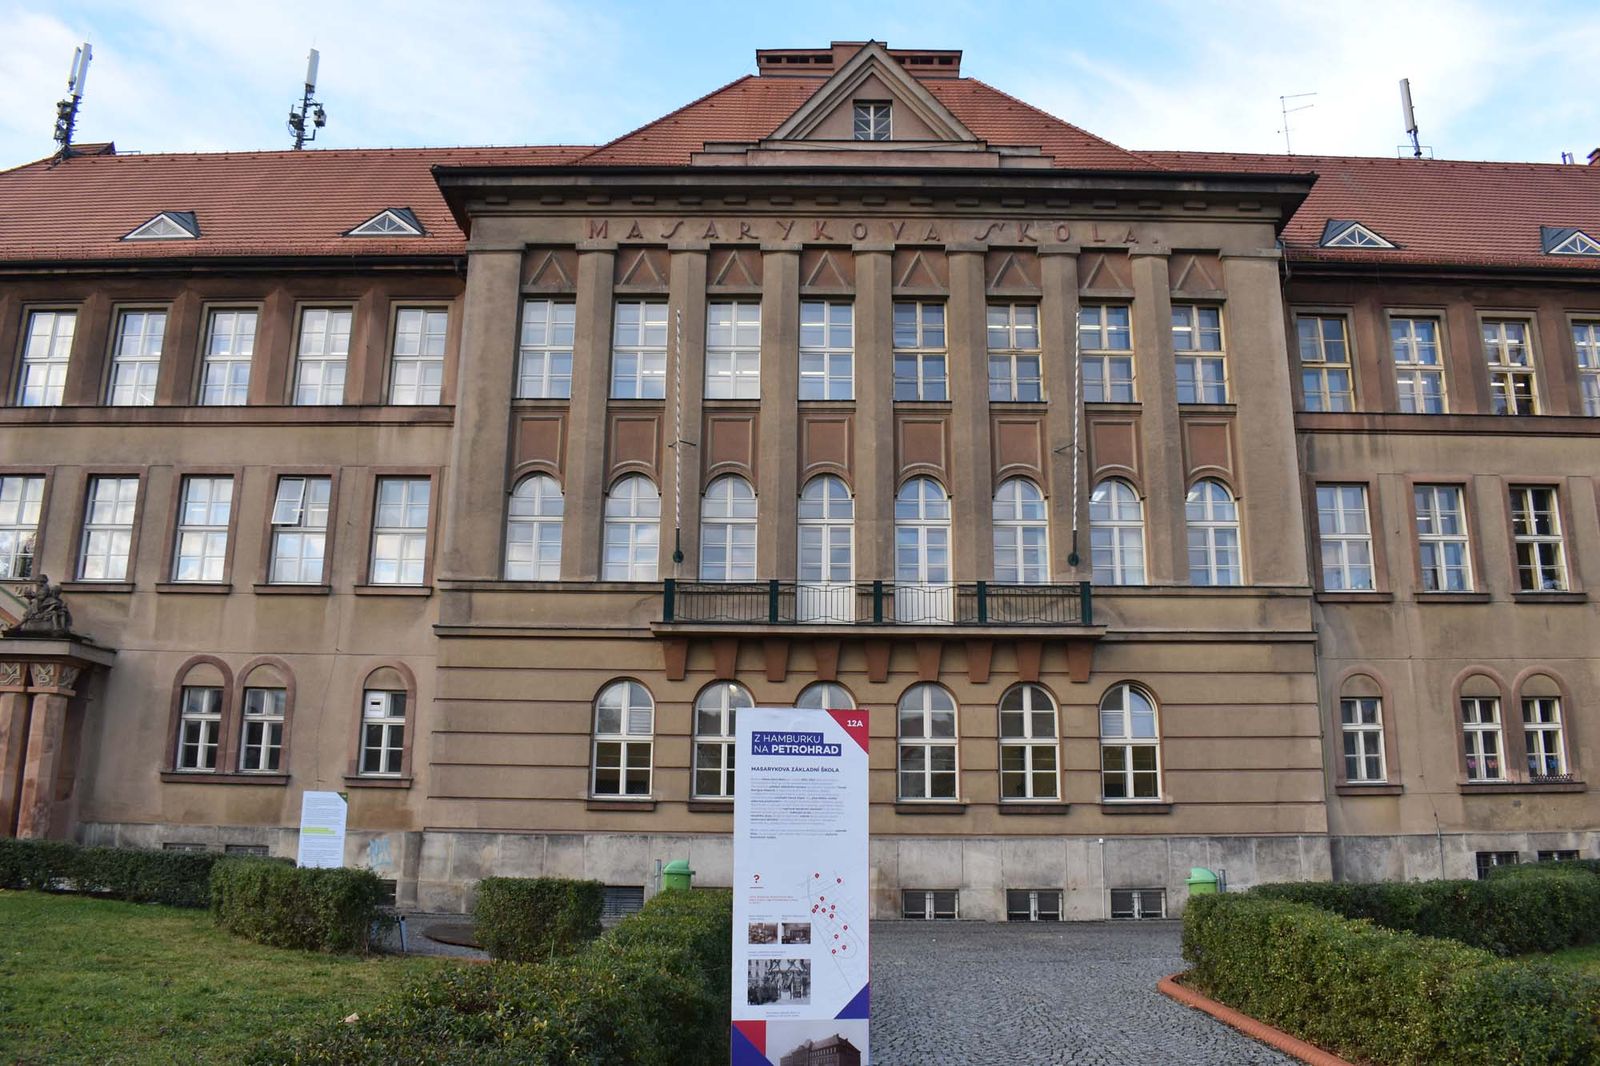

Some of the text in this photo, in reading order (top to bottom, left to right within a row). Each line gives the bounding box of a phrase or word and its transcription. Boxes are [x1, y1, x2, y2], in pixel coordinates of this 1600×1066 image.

[588, 219, 940, 240] MASARYKOVA
[754, 734, 821, 743] Z HAMBURKU
[754, 745, 839, 755] NA PETROHRAD
